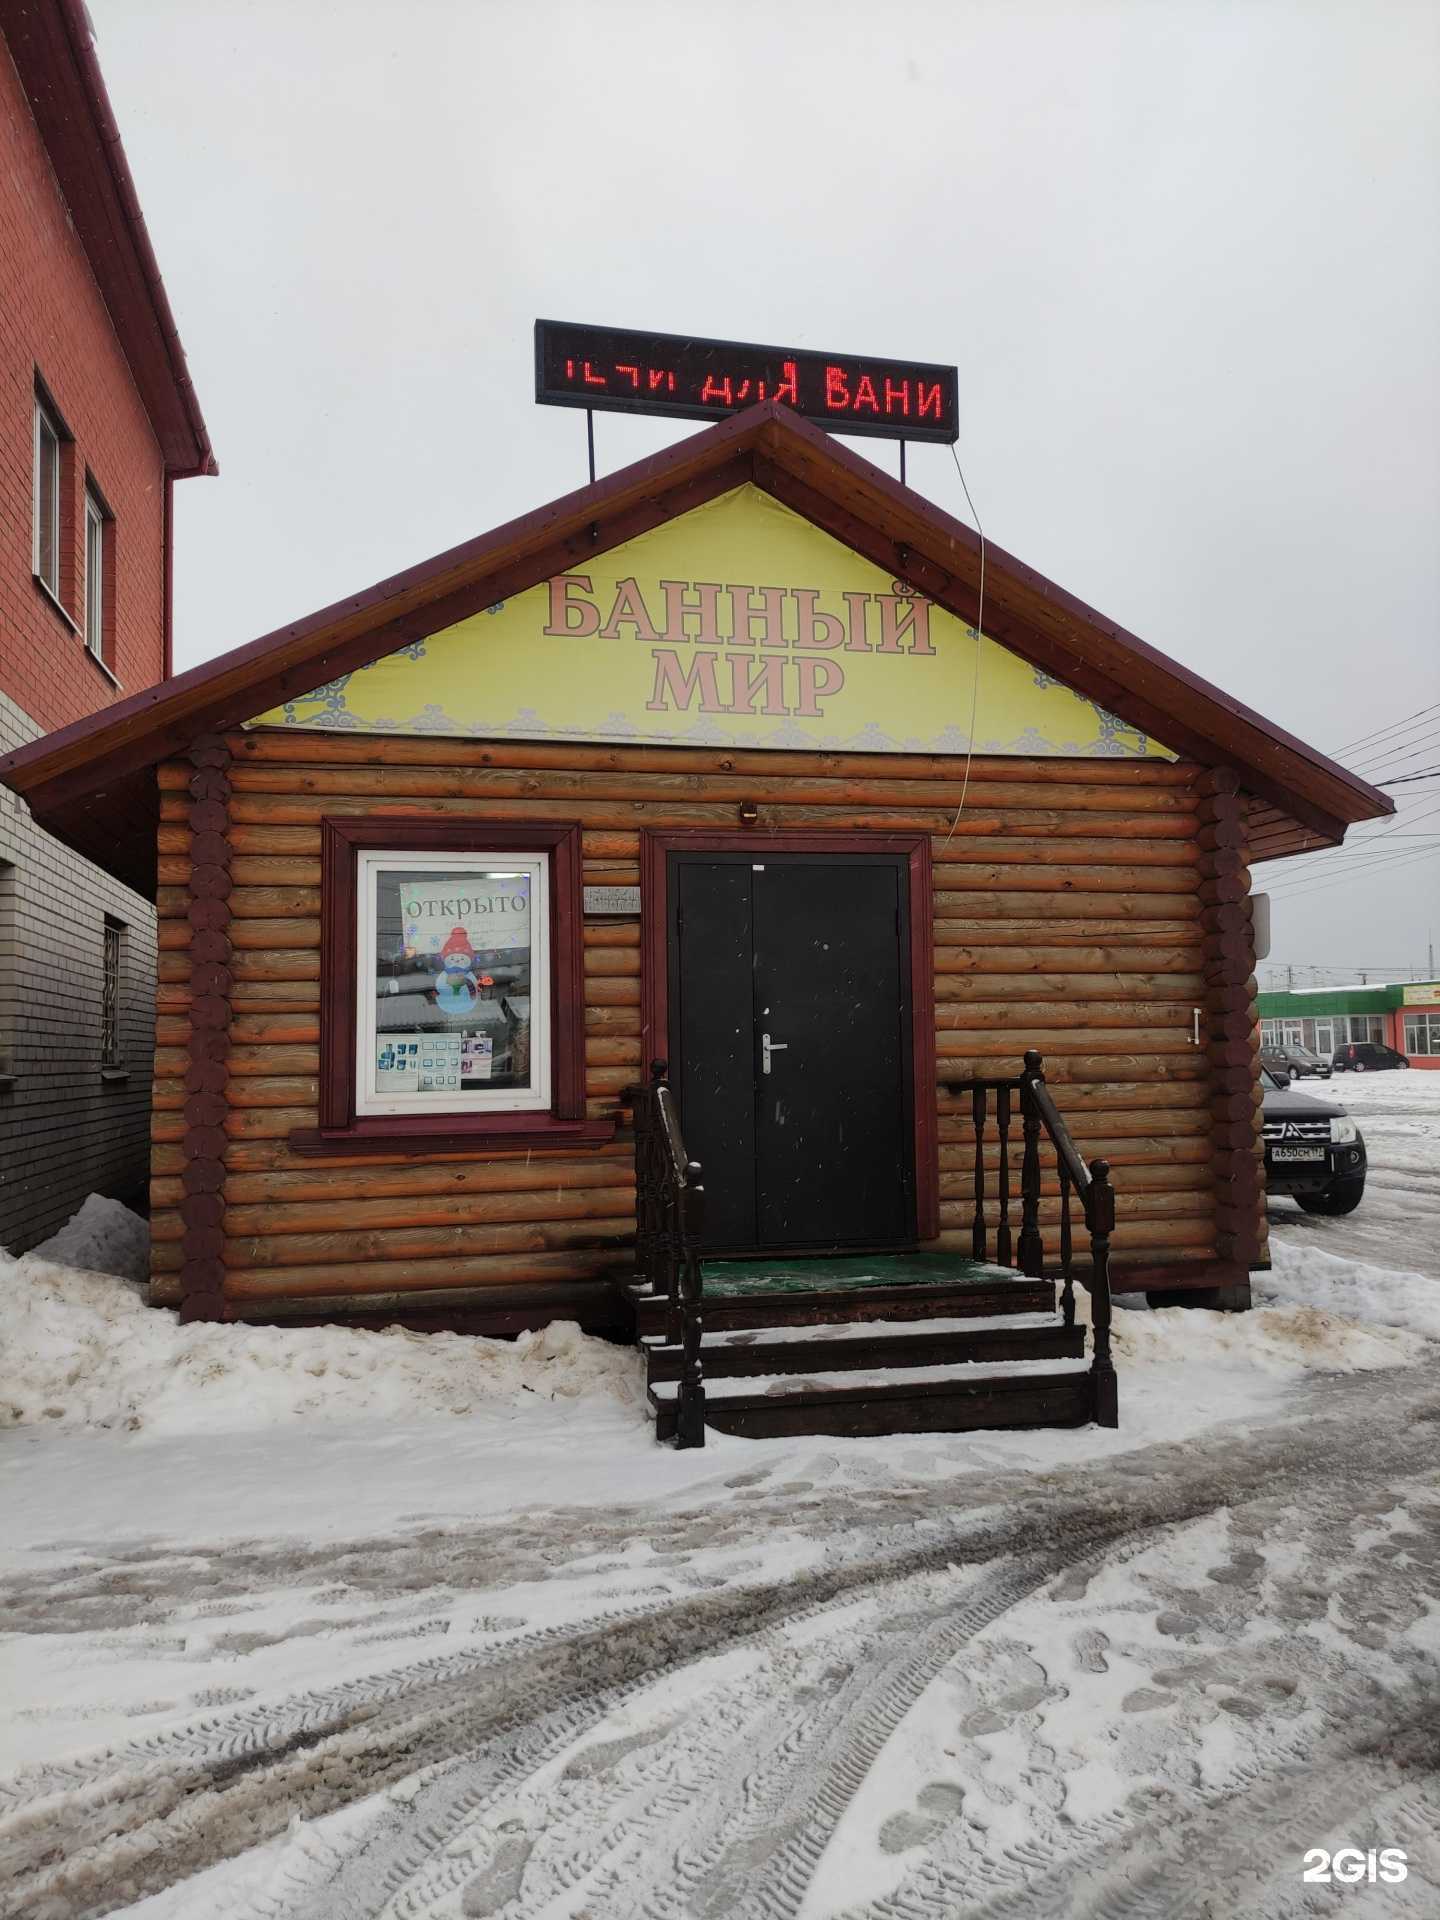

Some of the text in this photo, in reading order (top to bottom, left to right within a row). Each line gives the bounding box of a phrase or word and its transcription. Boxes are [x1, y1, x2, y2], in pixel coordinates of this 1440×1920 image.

[543, 574, 936, 655] БАННЫЙ
[646, 649, 845, 717] МИР
[407, 895, 526, 920] открыто
